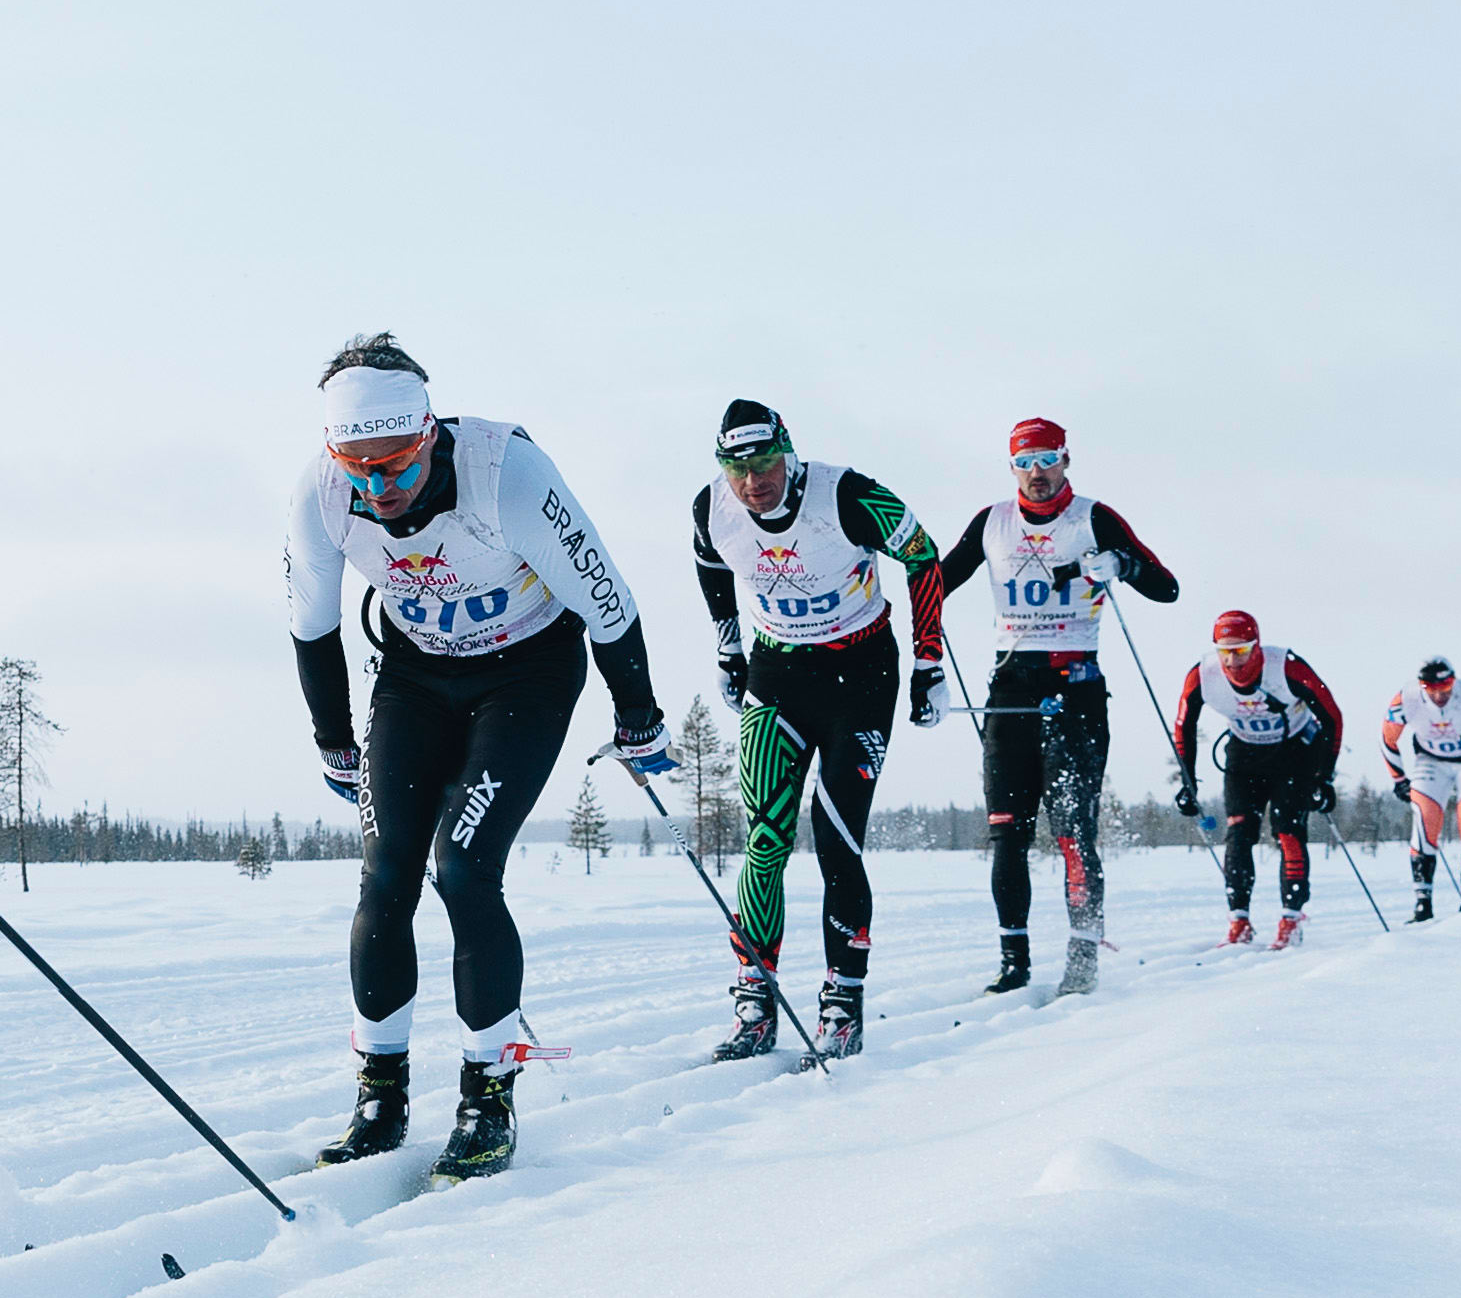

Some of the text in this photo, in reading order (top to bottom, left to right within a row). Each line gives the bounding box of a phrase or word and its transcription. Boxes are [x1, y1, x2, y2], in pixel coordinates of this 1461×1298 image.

[757, 563, 805, 574] Red Bull
[1003, 579, 1071, 607] 101
